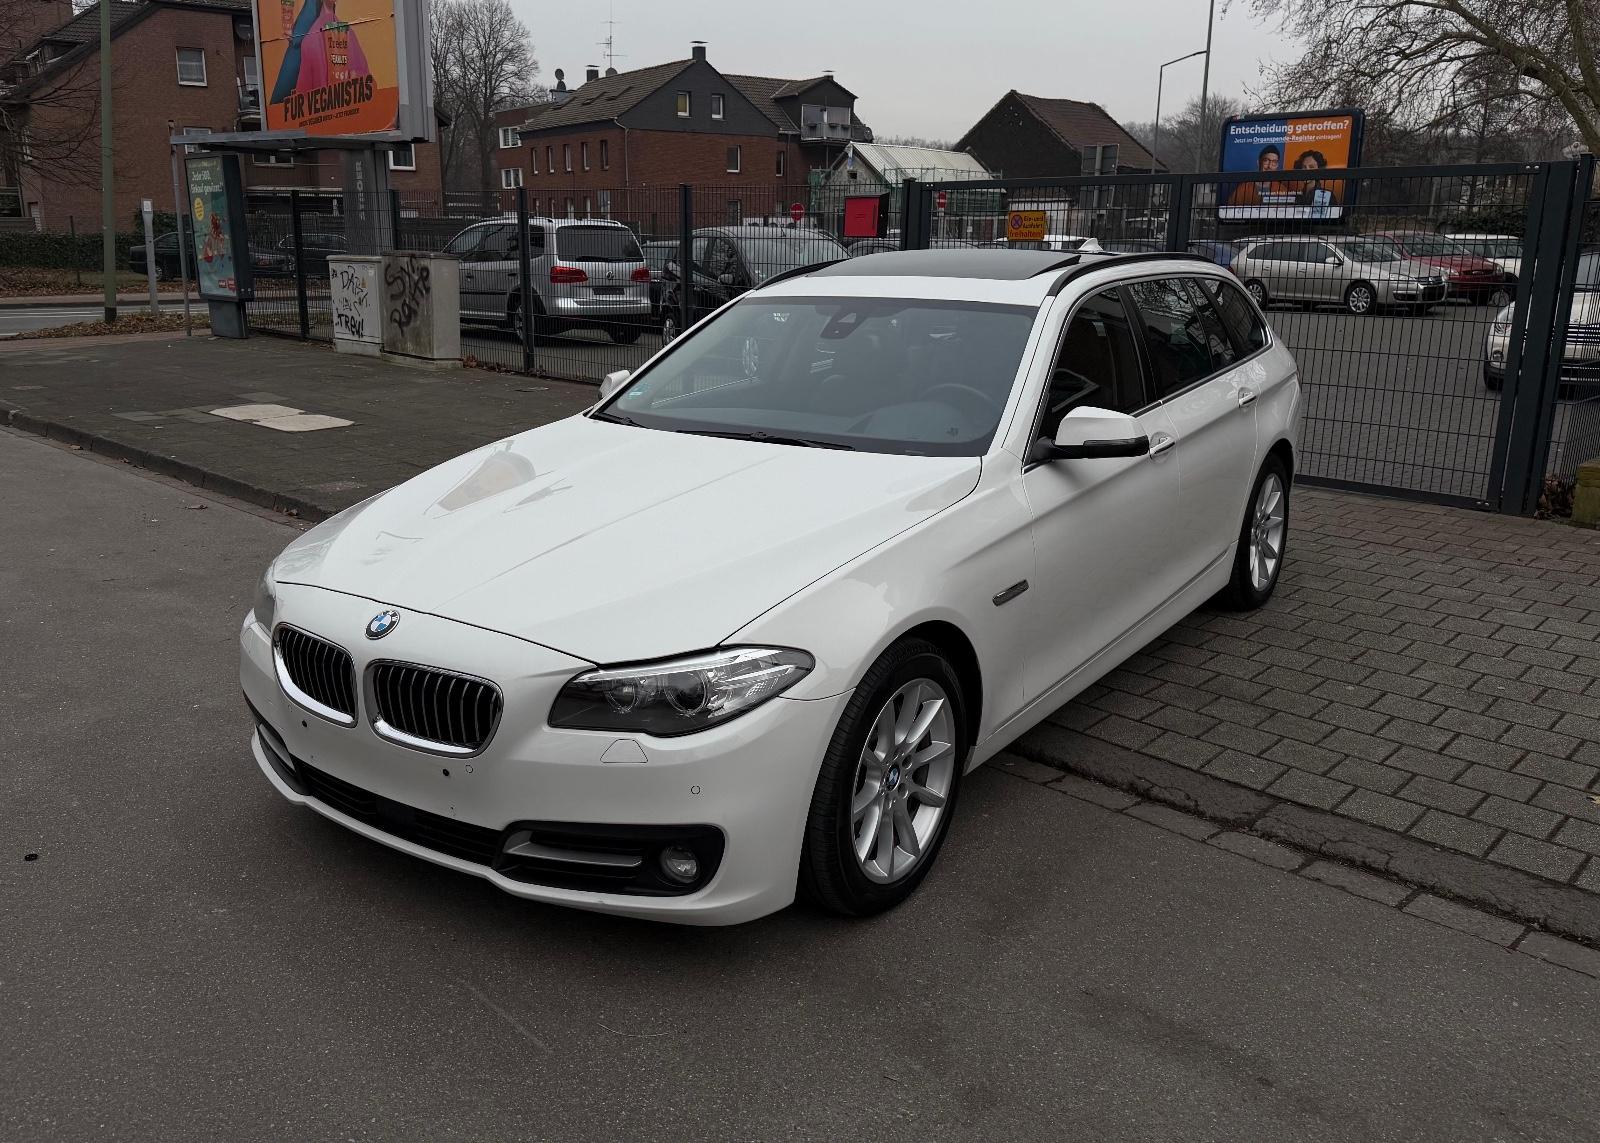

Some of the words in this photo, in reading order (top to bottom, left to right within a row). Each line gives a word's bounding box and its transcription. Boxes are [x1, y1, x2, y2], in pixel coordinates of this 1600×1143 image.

[283, 88, 305, 122] FÜR
[307, 75, 374, 115] VEGANISTAS
[1230, 124, 1293, 135] Entscheidung
[1295, 120, 1349, 133] getroffen?
[1253, 135, 1315, 143] Organspende-Register
